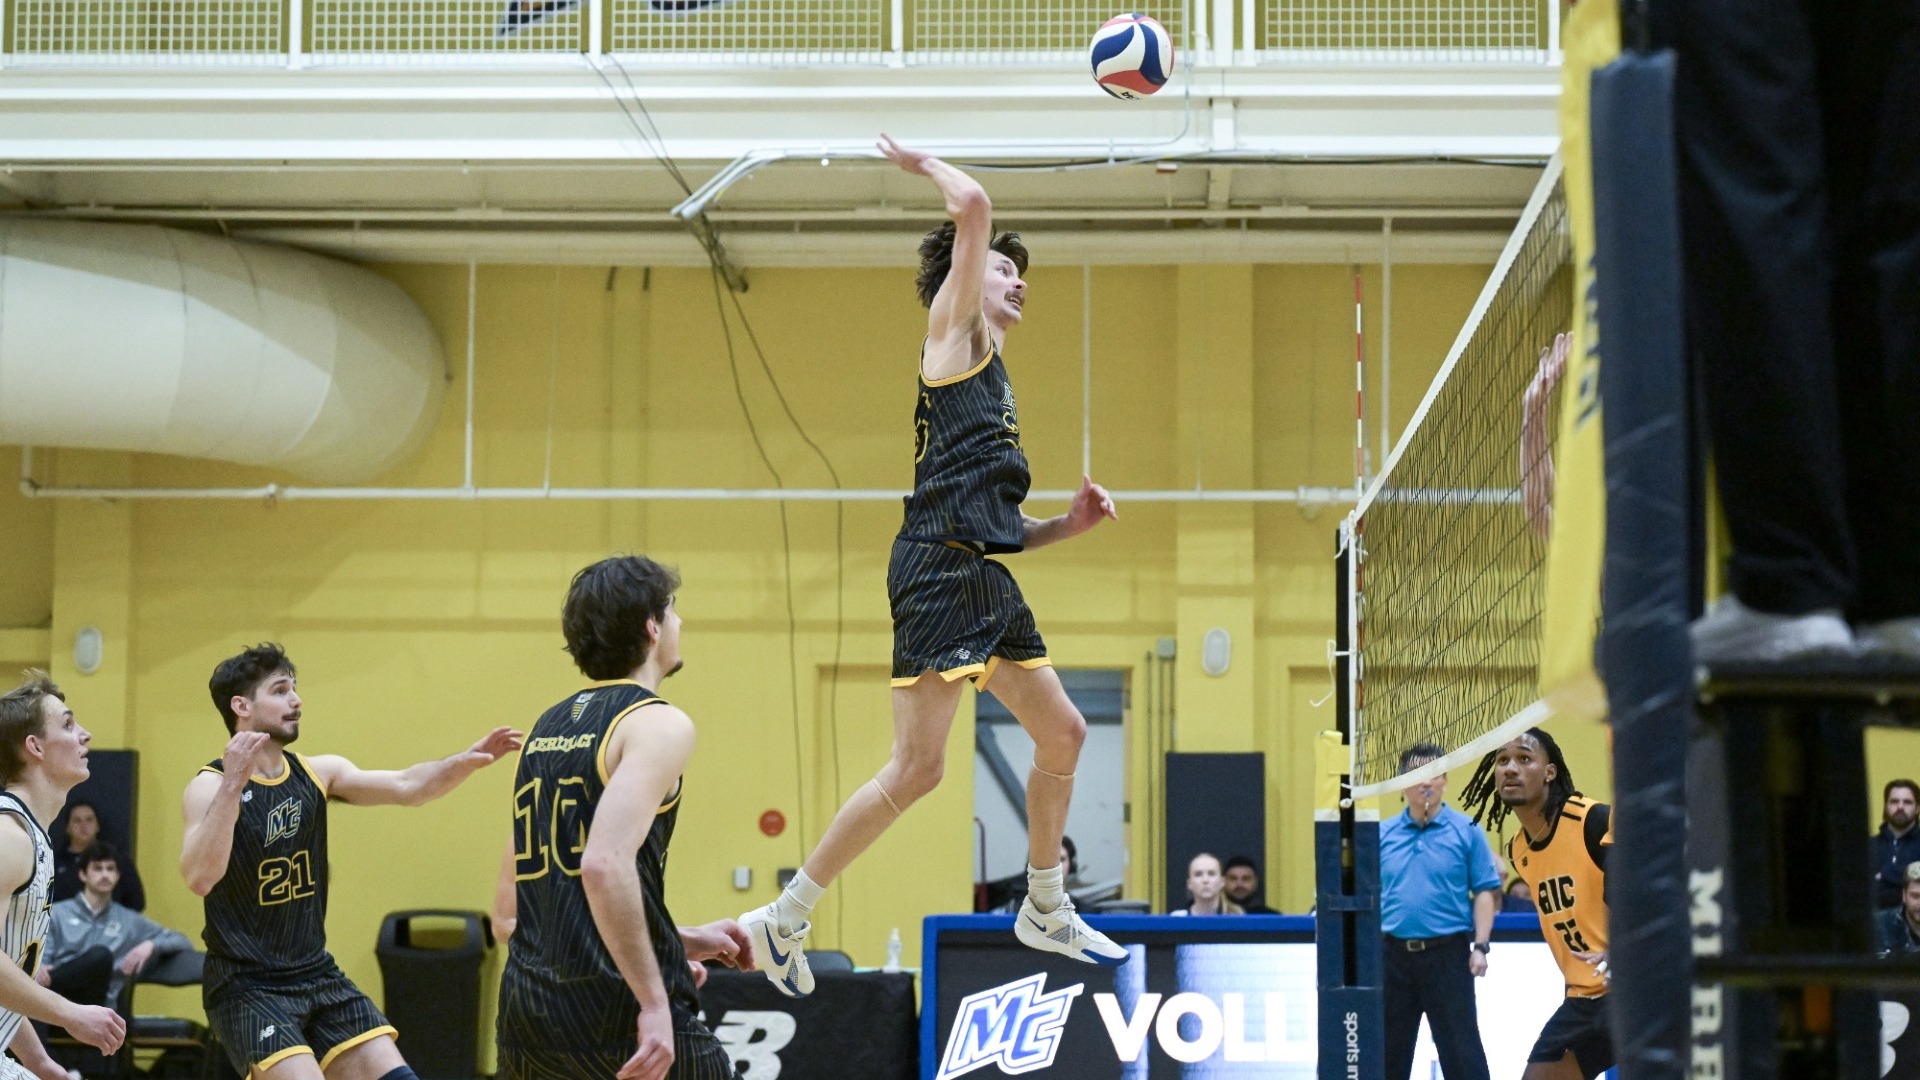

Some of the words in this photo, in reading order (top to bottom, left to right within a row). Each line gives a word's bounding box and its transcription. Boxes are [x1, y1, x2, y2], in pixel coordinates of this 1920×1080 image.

[258, 850, 315, 906] 21
[1538, 875, 1576, 916] AIC
[935, 971, 1085, 1080] MC
[1093, 992, 1318, 1063] VOLL
